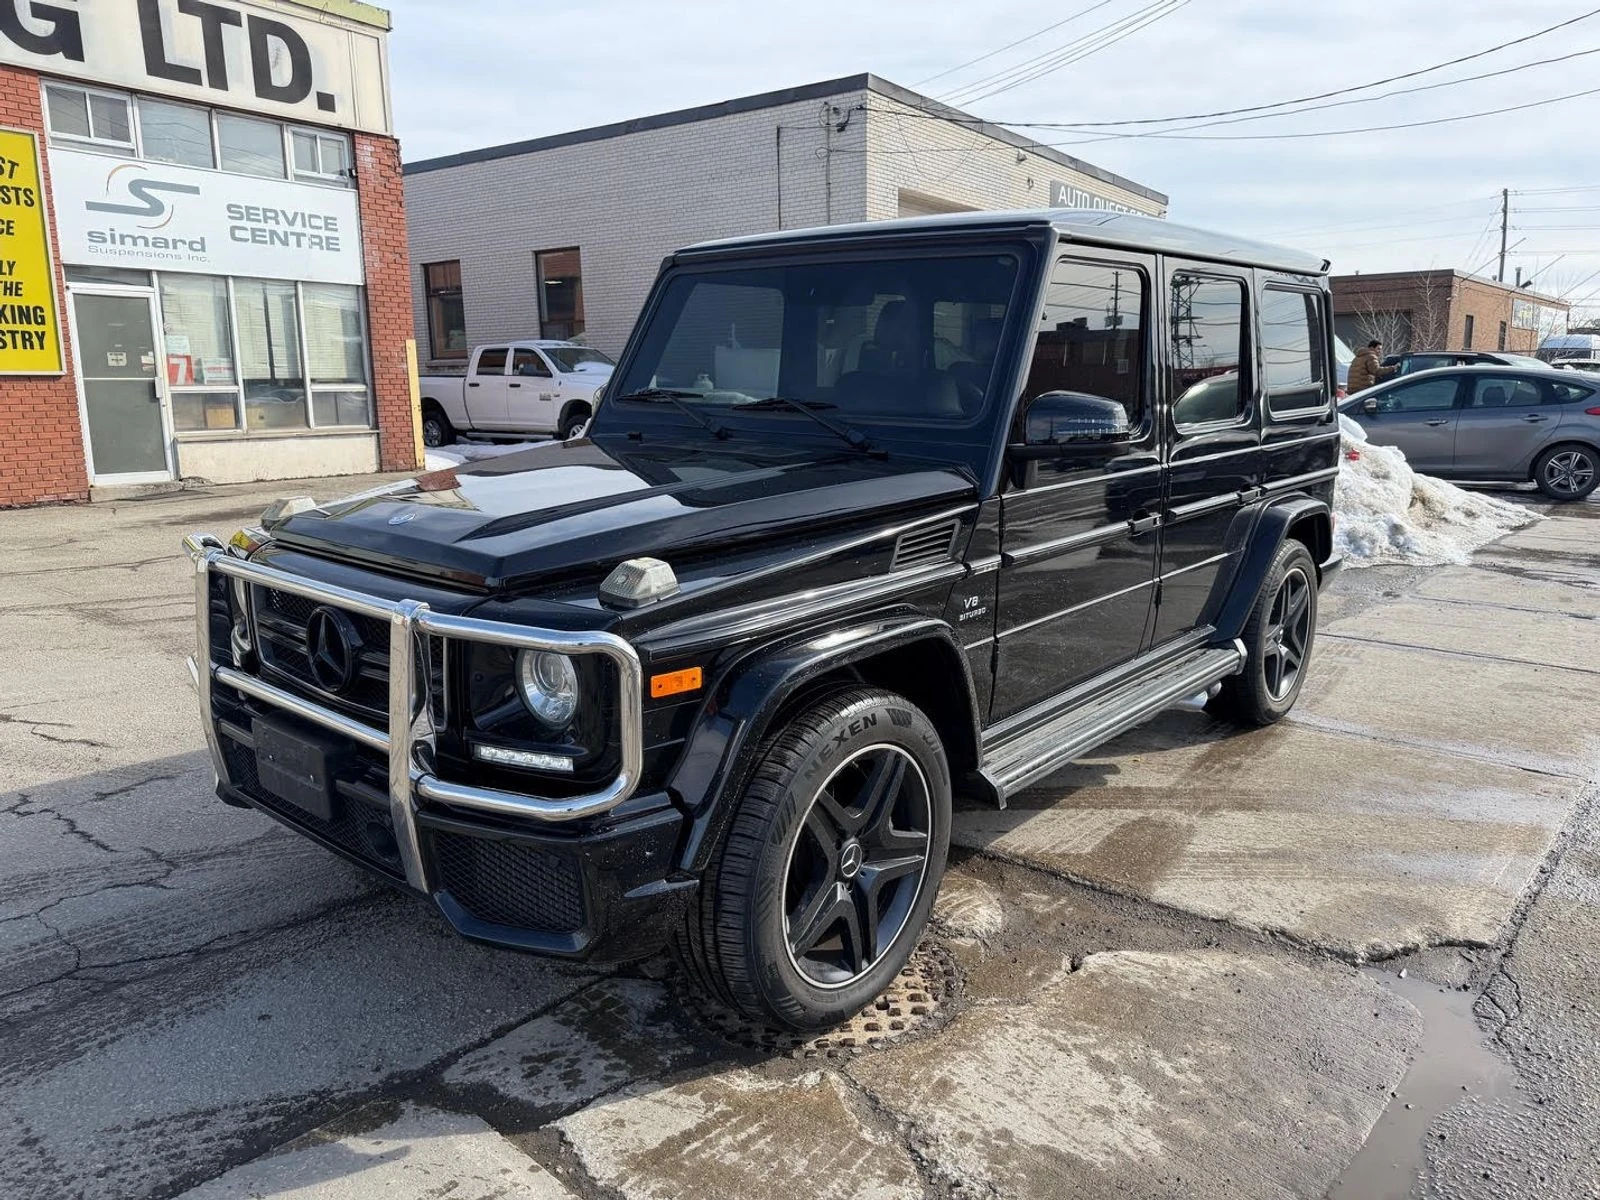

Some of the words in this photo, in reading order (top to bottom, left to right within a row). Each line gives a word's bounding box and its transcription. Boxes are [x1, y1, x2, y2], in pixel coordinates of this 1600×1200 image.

[137, 0, 336, 113] LTD.
[1058, 186, 1089, 210] AUTO
[226, 203, 339, 232] SERVICE
[87, 228, 206, 252] simard
[229, 225, 340, 252] CENTRE
[88, 245, 182, 260] Suspensions
[187, 253, 210, 263] Inc.
[959, 607, 986, 621] BITURBO
[963, 595, 979, 609] V8
[804, 712, 877, 780] NEXEN
